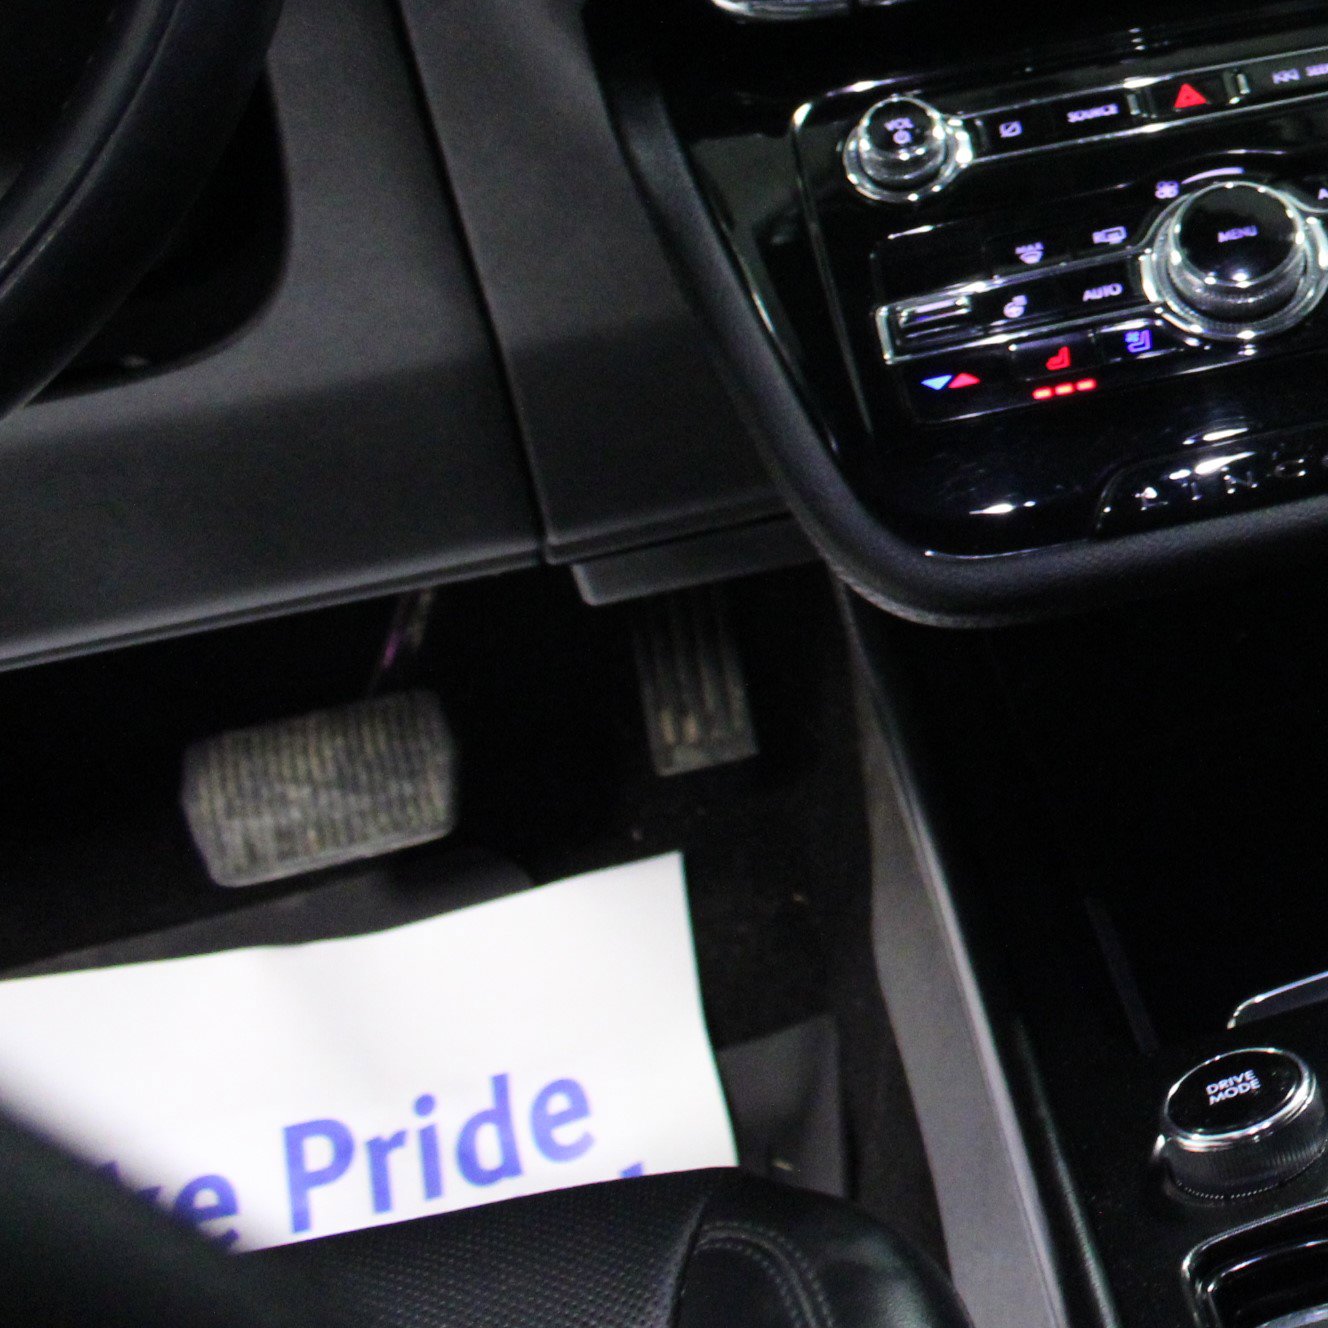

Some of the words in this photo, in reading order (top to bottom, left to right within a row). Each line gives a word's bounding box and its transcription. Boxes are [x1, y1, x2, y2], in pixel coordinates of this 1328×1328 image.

[1217, 224, 1259, 244] MENU
[1082, 282, 1124, 302] AUTO
[1205, 1069, 1256, 1096] DRIVE
[1209, 1078, 1261, 1107] MODE
[280, 1073, 594, 1236] Pride
